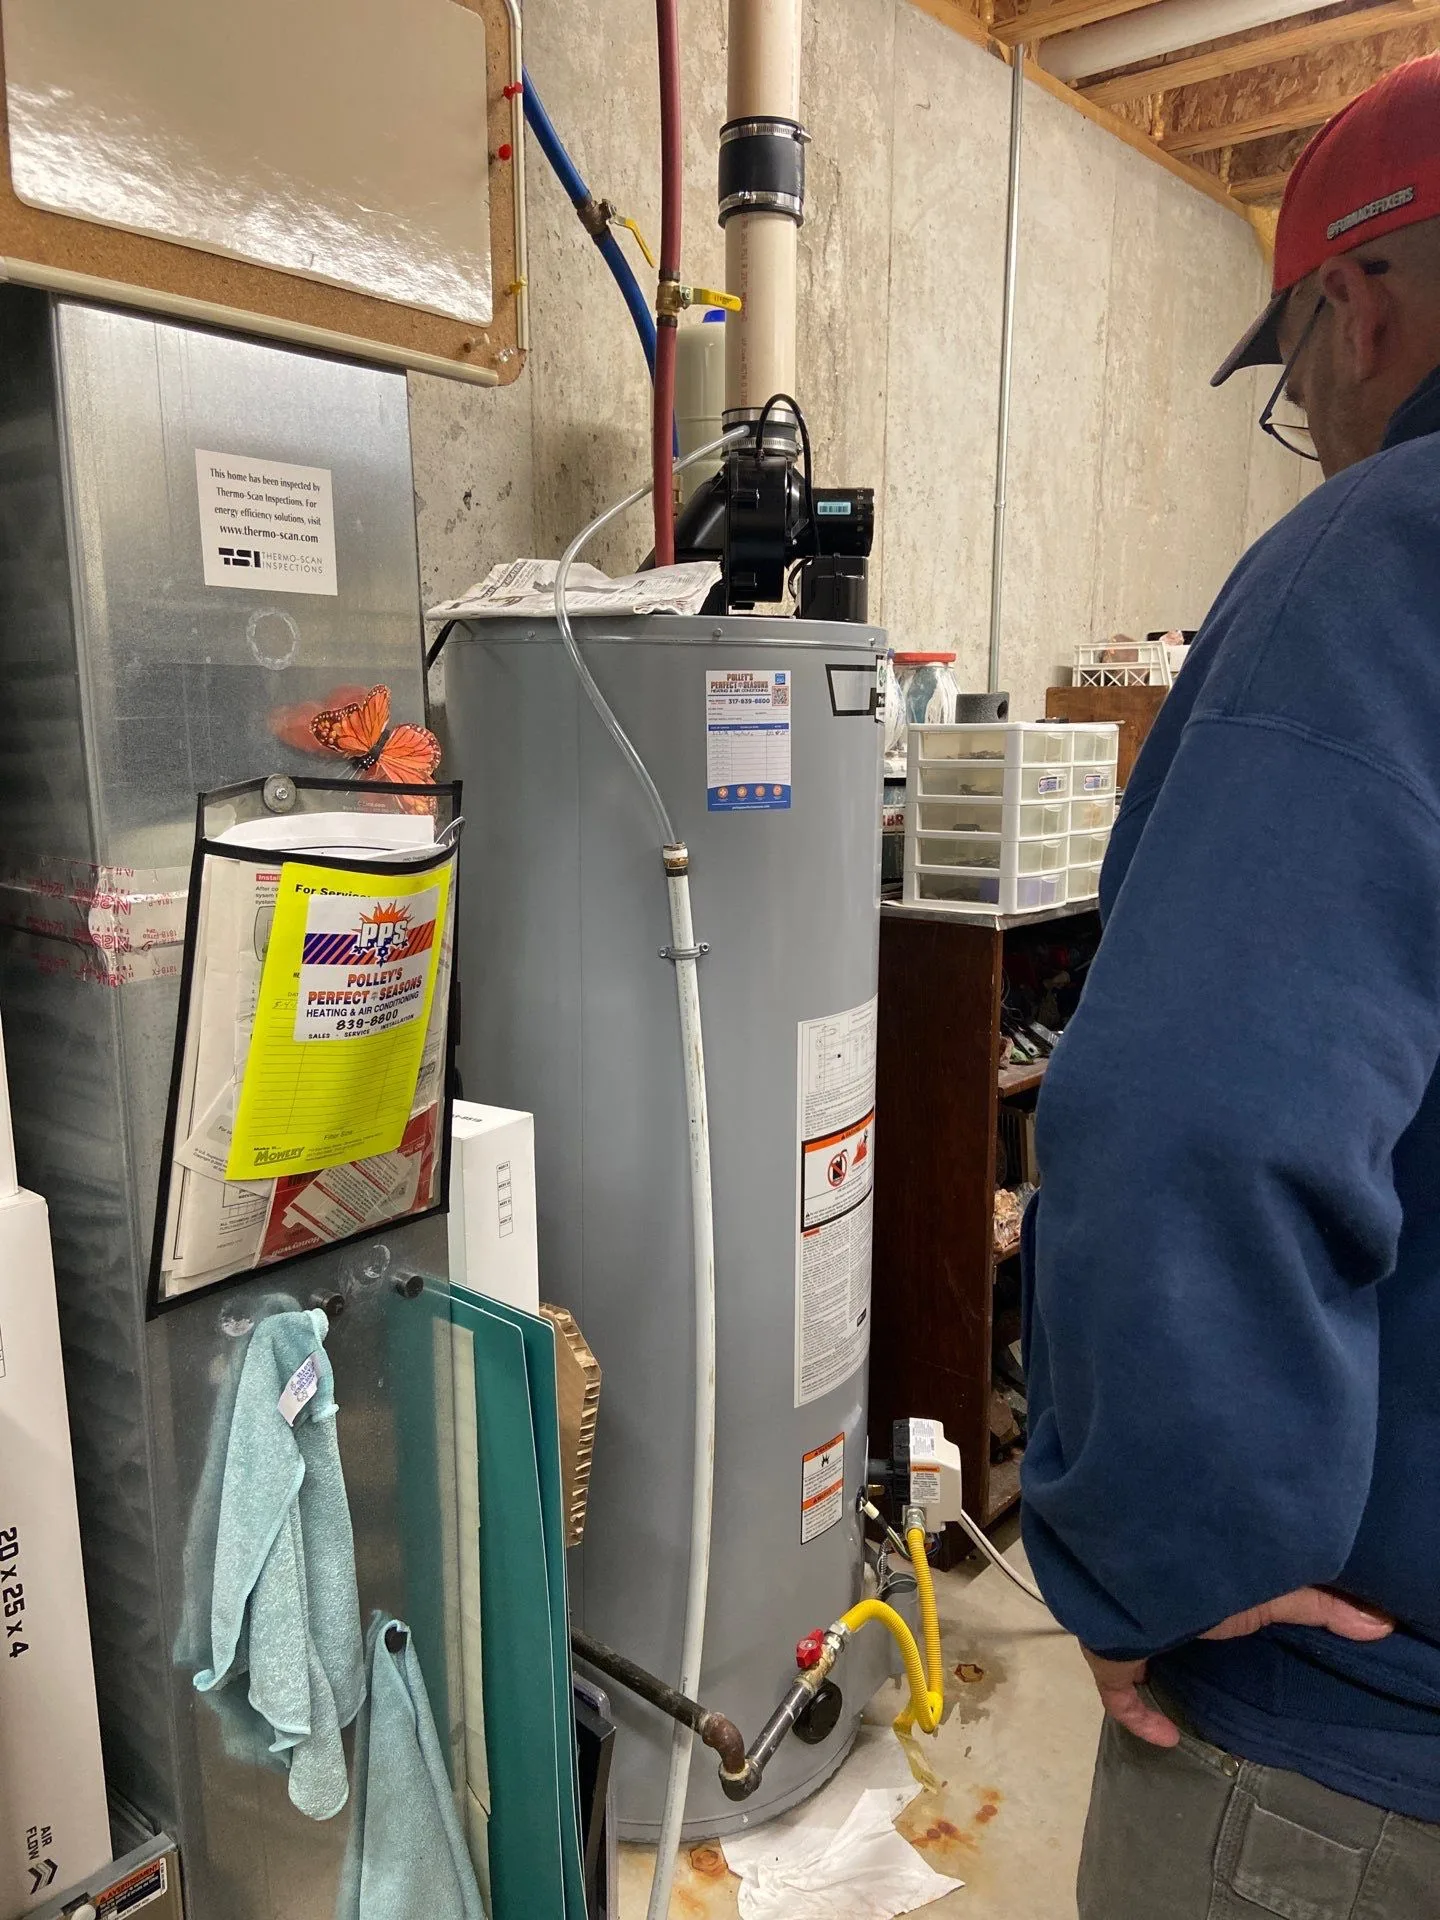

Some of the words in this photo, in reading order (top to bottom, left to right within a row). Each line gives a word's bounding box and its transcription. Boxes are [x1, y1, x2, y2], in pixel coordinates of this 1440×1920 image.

[210, 468, 225, 478] This
[227, 470, 247, 481] home
[249, 473, 261, 483] has
[263, 476, 279, 486] been
[280, 478, 311, 491] inspected
[313, 482, 320, 492] by
[216, 487, 264, 501] Thermo-Scan
[265, 494, 304, 507] Inspections.
[305, 499, 317, 508] For
[215, 507, 238, 518] energy
[240, 508, 272, 520] efficiency
[274, 513, 306, 525] solutions,
[308, 517, 321, 526] visit
[219, 525, 319, 543] www.thermo-scan.com
[262, 551, 323, 564] THERMO-SCAN
[262, 562, 323, 574] INSPECTIONS
[295, 883, 317, 895] For
[361, 920, 409, 947] PPS
[347, 967, 403, 988] POLLEY'S
[307, 990, 370, 1005] PERFECT
[379, 975, 422, 1001] SEASONS
[306, 1008, 347, 1018] HEATING
[350, 1008, 356, 1016] &
[358, 1005, 373, 1016] AIR
[374, 991, 419, 1012] CONDITIONING
[336, 1008, 399, 1031] 839-8800
[344, 1029, 370, 1038] SERVICE
[380, 1013, 415, 1031] INSTALLATION
[0, 1526, 19, 1561] 20
[3, 1583, 25, 1617] 25
[9, 1641, 29, 1658] 4
[26, 1826, 39, 1860] FLOW
[41, 1826, 52, 1847] AIR
